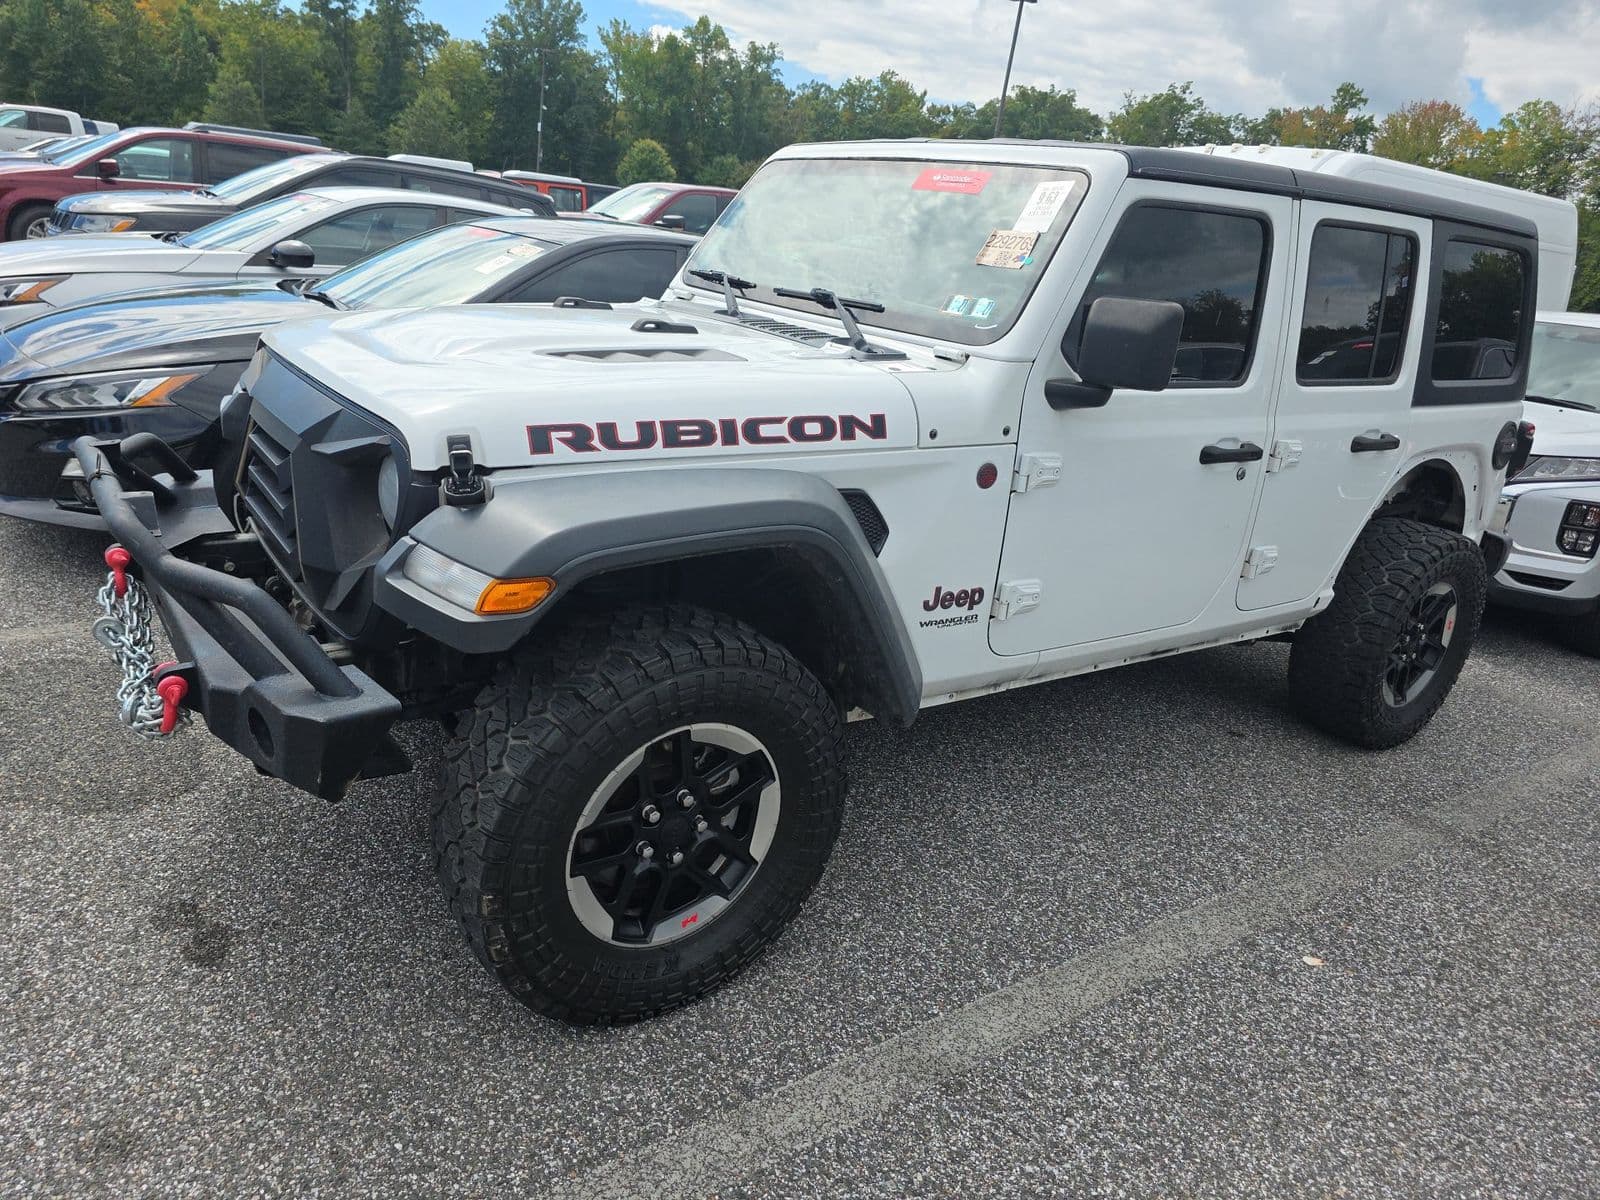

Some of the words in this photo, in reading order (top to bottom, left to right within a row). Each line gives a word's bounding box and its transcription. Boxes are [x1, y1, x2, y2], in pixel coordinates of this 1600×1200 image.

[526, 413, 888, 455] RUBICON
[923, 586, 985, 612] Jeep
[919, 614, 978, 628] WRANGLER
